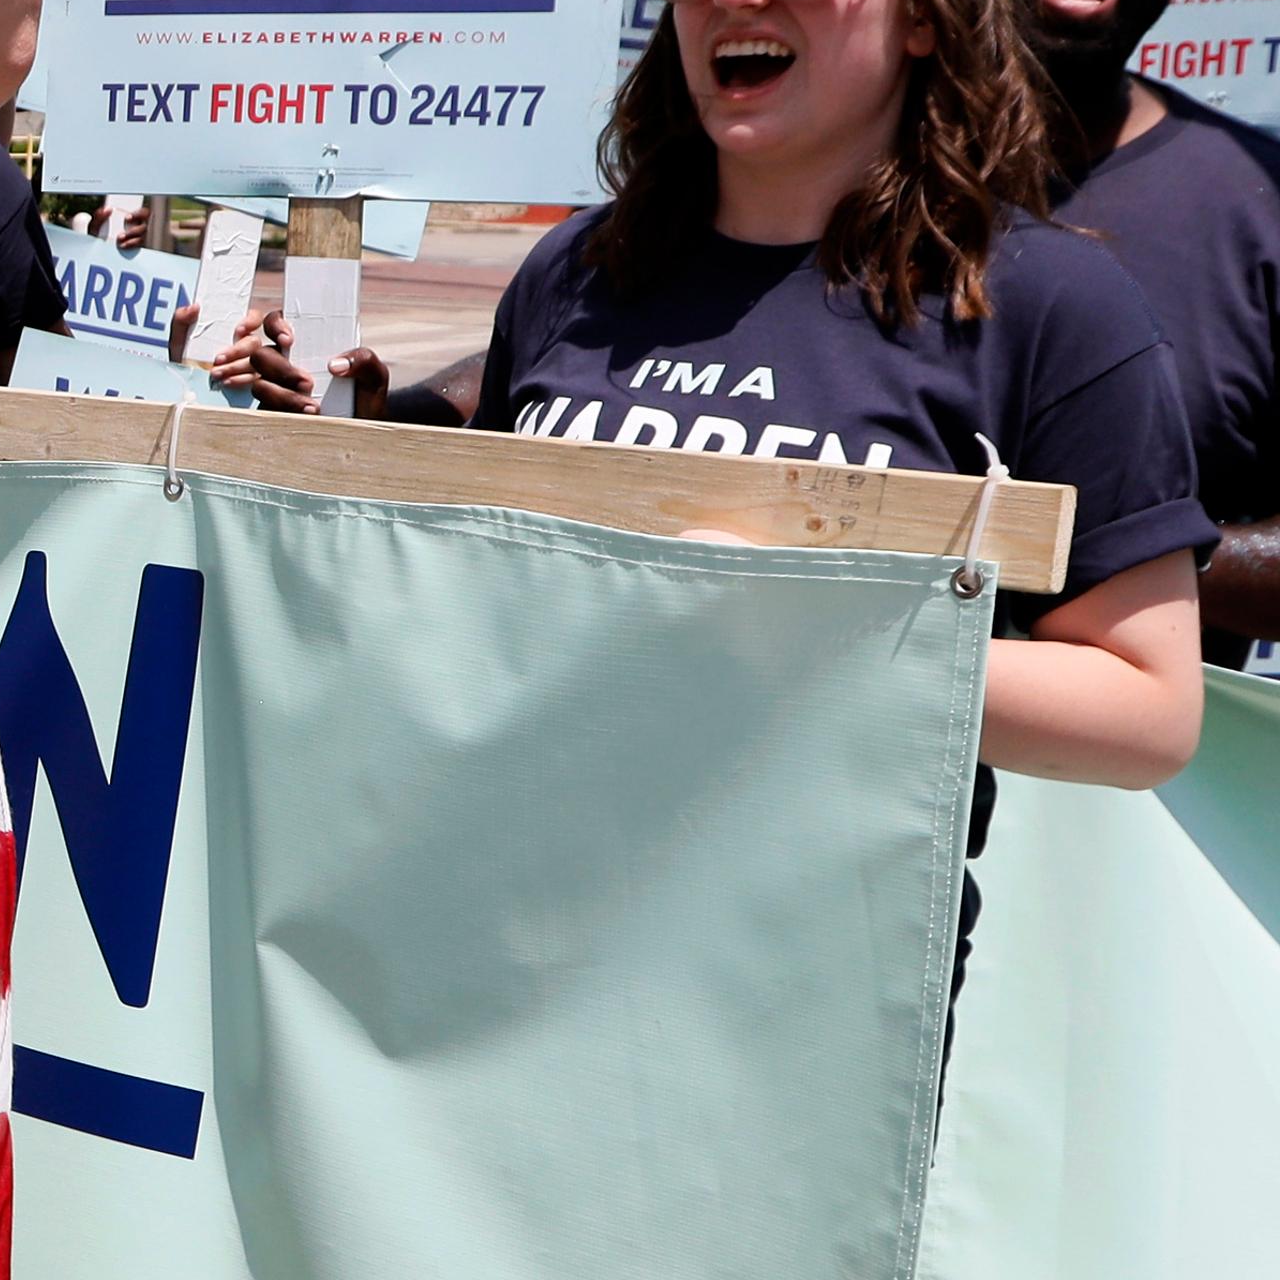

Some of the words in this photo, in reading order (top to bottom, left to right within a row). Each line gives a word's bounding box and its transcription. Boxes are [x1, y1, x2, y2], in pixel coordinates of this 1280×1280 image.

[135, 30, 507, 46] WWW.ELIZABETHWARREN.COM
[1139, 37, 1254, 79] FIGHT
[102, 83, 200, 122] TEXT
[209, 82, 334, 124] FIGHT
[343, 84, 398, 125] TO
[408, 84, 547, 126] 24477
[51, 255, 190, 331] ARRE
[629, 358, 726, 395] I'M
[728, 366, 776, 401] A
